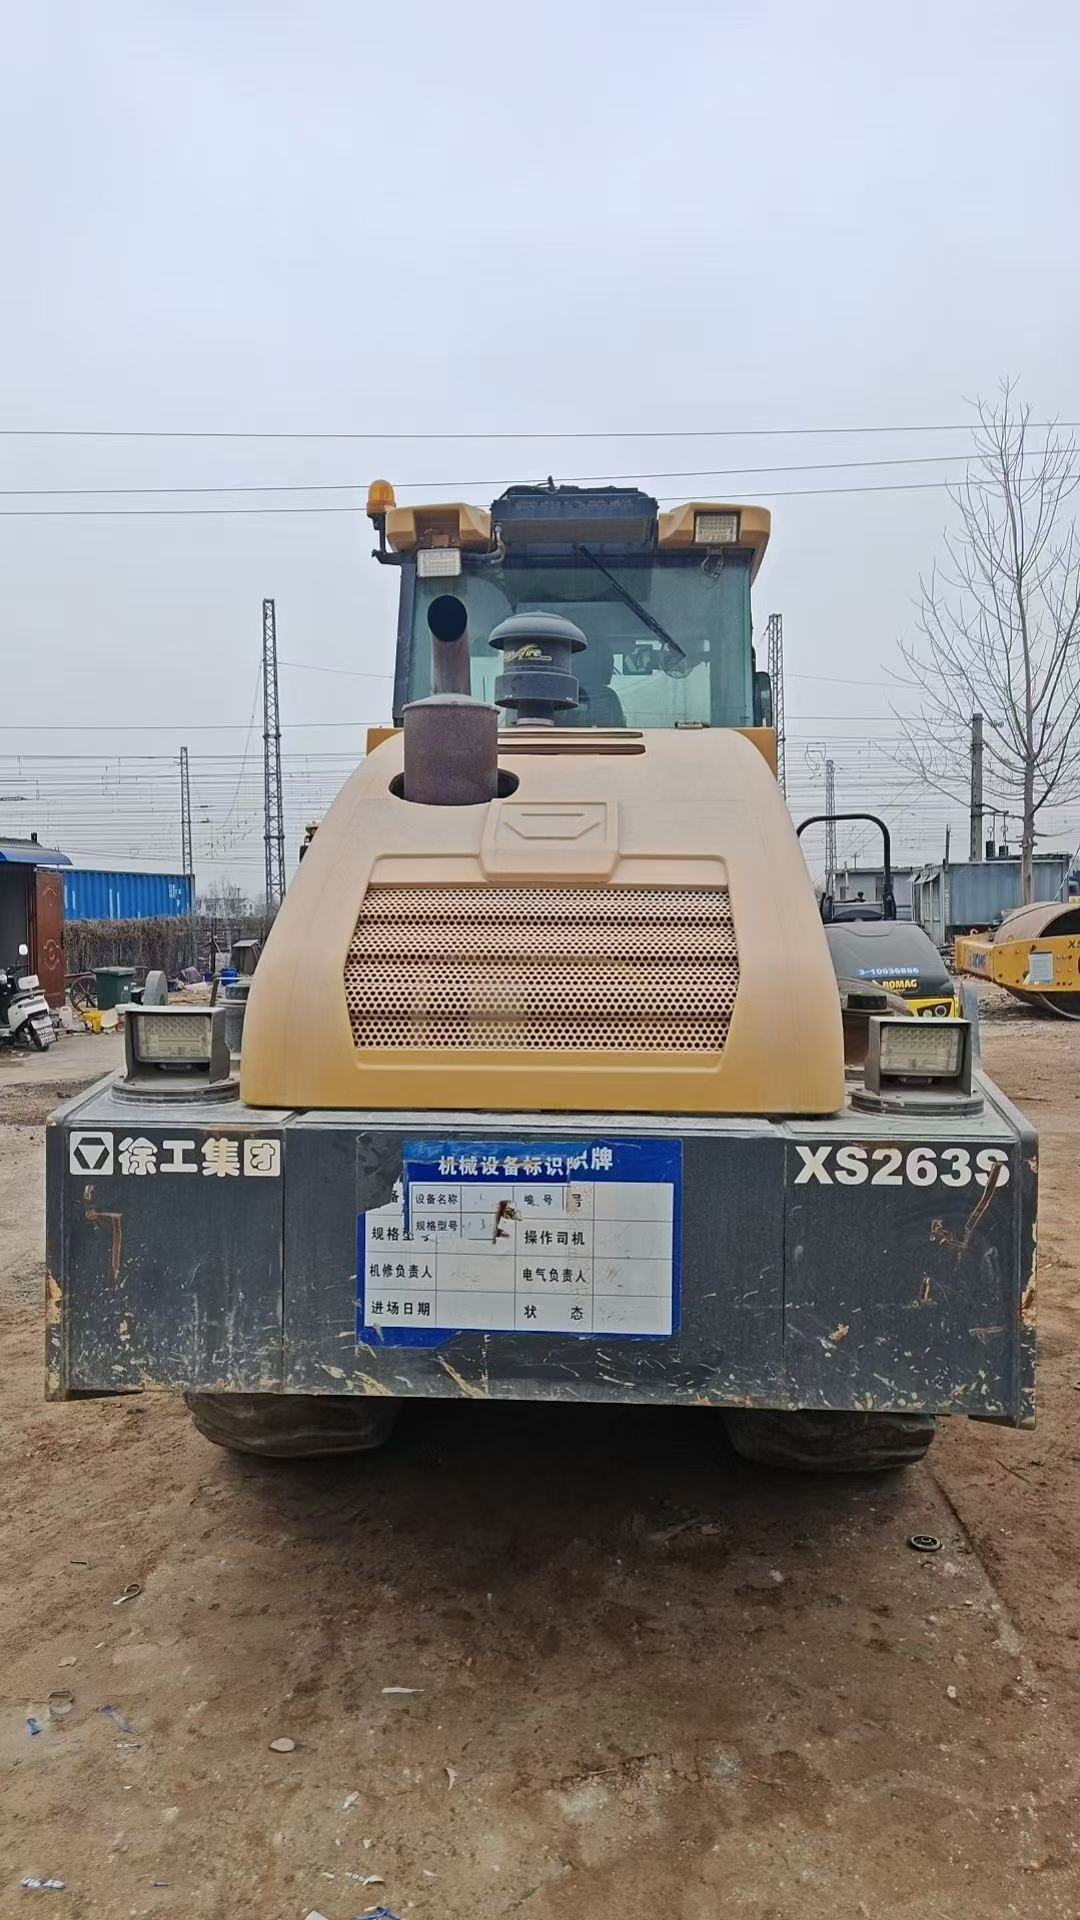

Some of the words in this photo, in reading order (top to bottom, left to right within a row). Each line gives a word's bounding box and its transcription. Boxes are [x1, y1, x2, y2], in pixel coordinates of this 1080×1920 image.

[118, 1136, 281, 1177] 徐工集团
[793, 1145, 1011, 1188] XS263S
[415, 1193, 459, 1206] 设备名称
[415, 1220, 459, 1232] 规格型号
[524, 1229, 586, 1246] 操作司机
[369, 1263, 433, 1279] 机修负责人
[522, 1267, 588, 1284] 电气负责人
[371, 1300, 431, 1317] 进场日期
